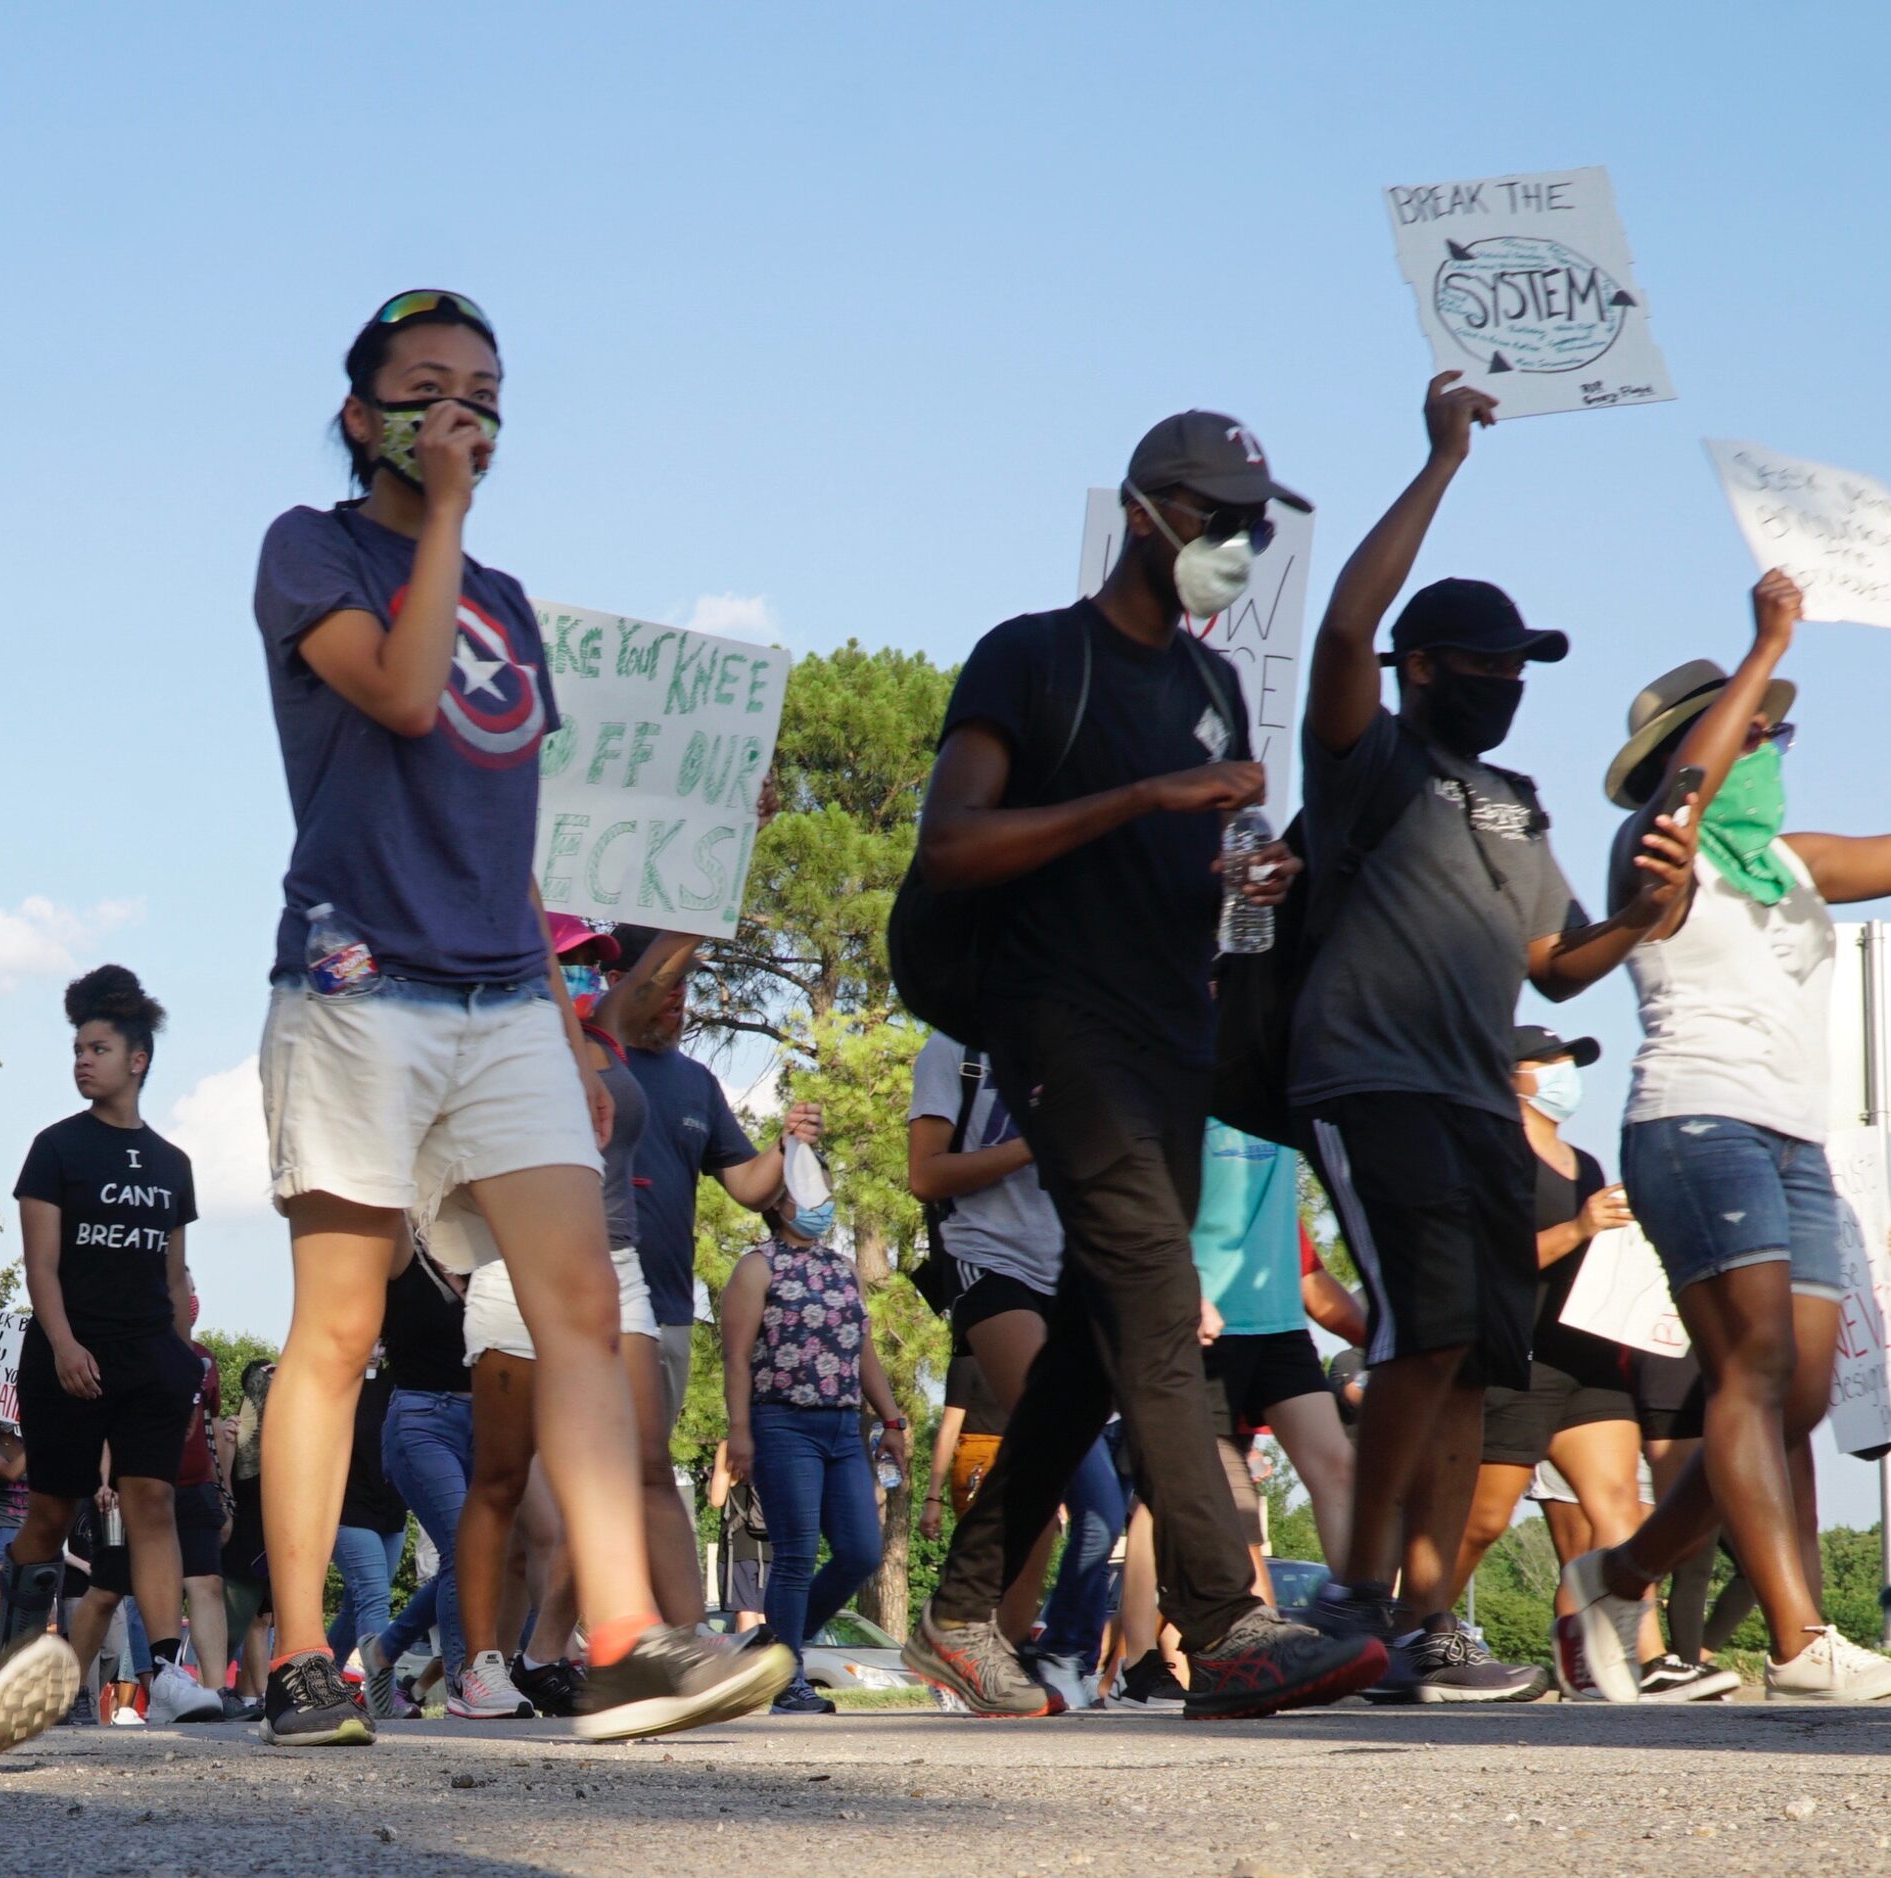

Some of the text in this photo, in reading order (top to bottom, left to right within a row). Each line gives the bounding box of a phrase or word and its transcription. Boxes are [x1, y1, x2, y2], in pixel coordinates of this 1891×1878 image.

[1388, 181, 1575, 225] BREAK THE
[1444, 267, 1607, 329] SYSTEM
[662, 631, 770, 715] KNEE
[539, 714, 762, 814] OFF OUR
[537, 808, 754, 924] ECKS!
[125, 1148, 143, 1169] I
[100, 1182, 174, 1210] CAN'T
[76, 1223, 170, 1256] BREATH
